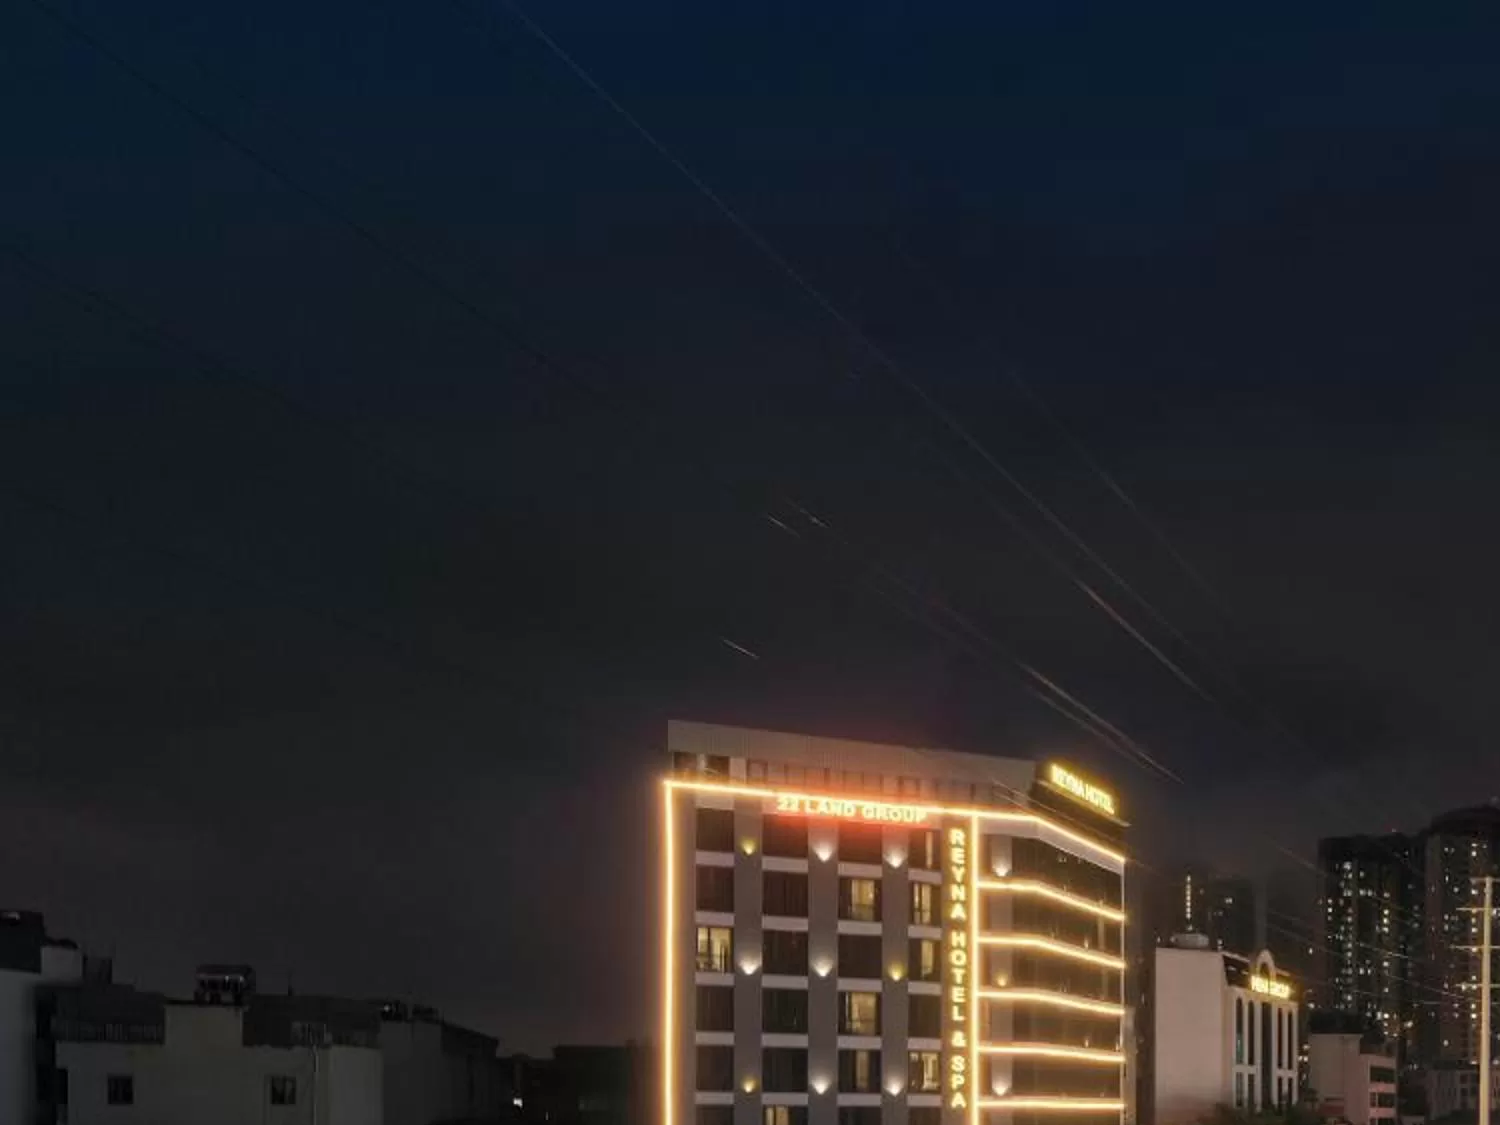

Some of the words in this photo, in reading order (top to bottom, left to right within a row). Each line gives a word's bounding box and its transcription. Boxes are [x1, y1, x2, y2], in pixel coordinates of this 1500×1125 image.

[805, 798, 857, 817] LAND
[862, 803, 928, 823] GROUP
[949, 828, 967, 920] REYNA
[950, 929, 967, 1021] HOTEL
[951, 1030, 967, 1047] &
[951, 1055, 967, 1109] SPA
